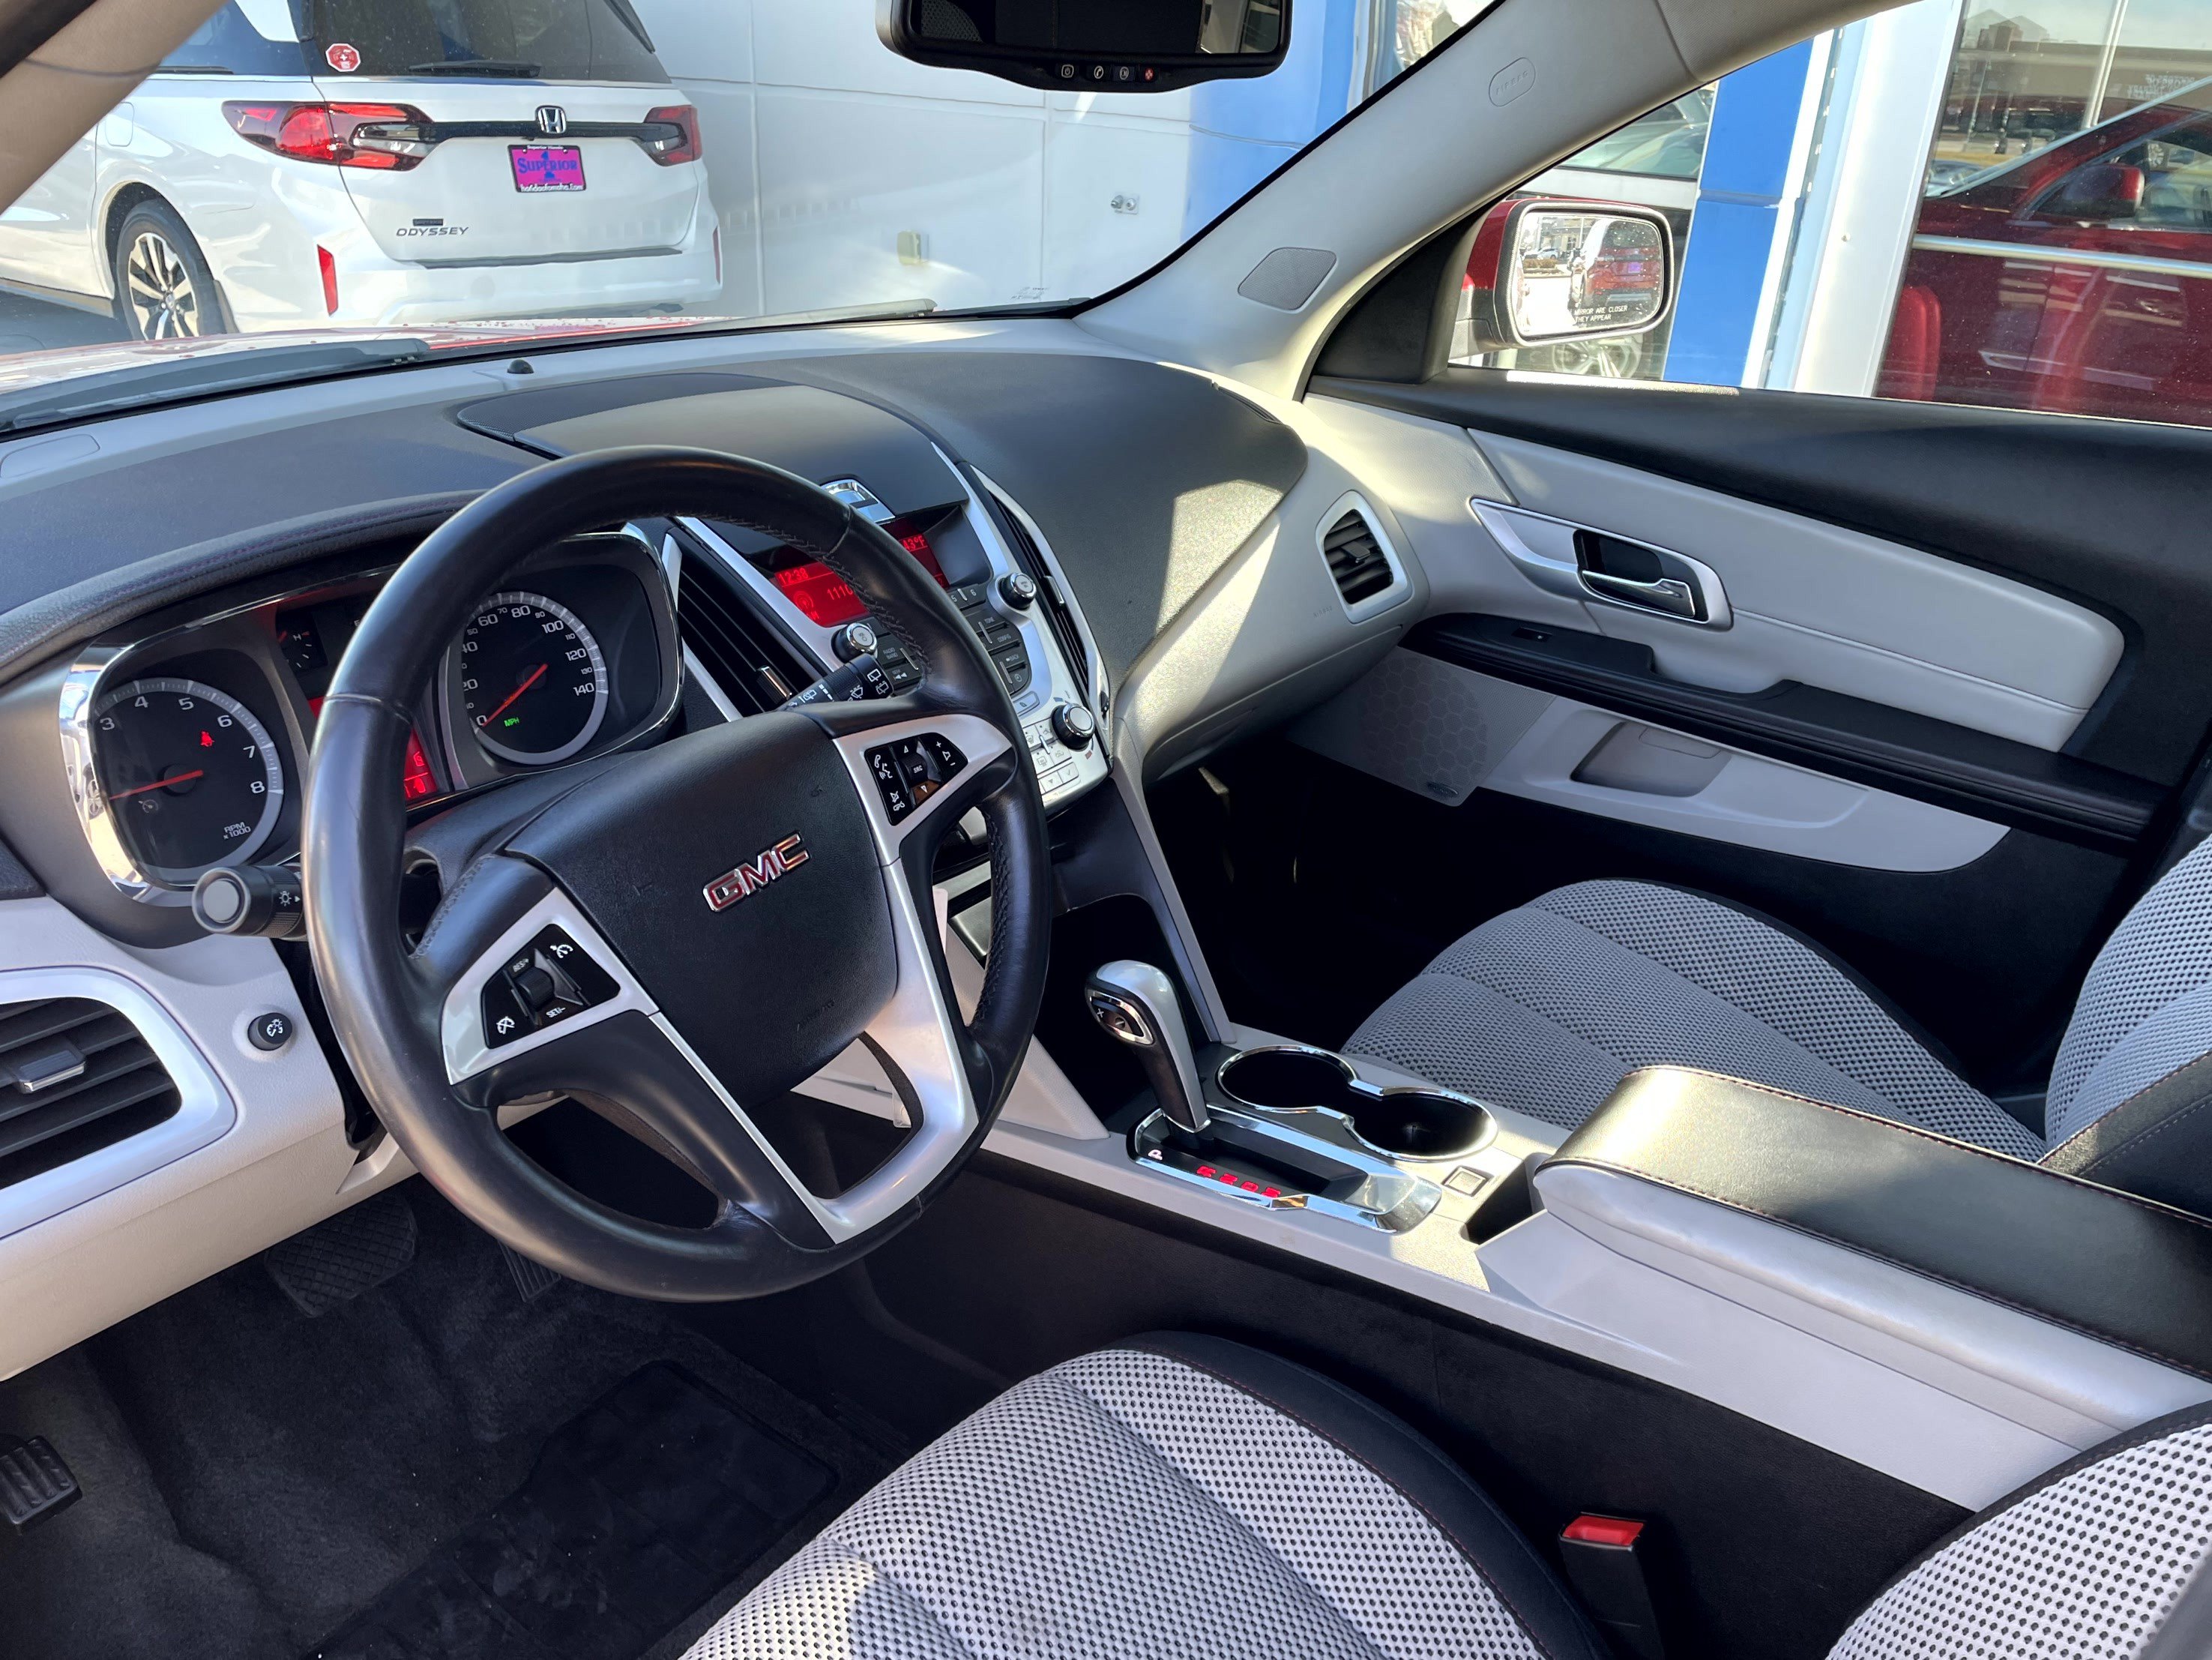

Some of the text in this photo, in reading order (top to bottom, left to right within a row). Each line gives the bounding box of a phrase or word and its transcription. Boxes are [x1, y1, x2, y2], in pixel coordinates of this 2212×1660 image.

[396, 226, 469, 236] ODYSSEY
[1591, 313, 1612, 322] APPEAR
[970, 589, 977, 597] 6
[510, 605, 531, 618] 80
[534, 610, 546, 619] 90
[477, 613, 498, 627] 60
[467, 628, 478, 636] 50
[542, 620, 564, 634] 100
[565, 648, 587, 661] 120
[580, 667, 593, 675] 130
[573, 682, 594, 697] 140
[134, 696, 149, 708] 4
[178, 697, 194, 710] 5
[100, 717, 115, 731] 3
[217, 715, 232, 727] 6
[476, 715, 487, 726] 0
[504, 717, 519, 727] MPH
[243, 745, 256, 758] 7
[913, 765, 923, 774] SRC
[250, 781, 265, 794] 8
[224, 822, 246, 833] RPM
[703, 833, 809, 912] GMC
[1148, 1149, 1163, 1161] P
